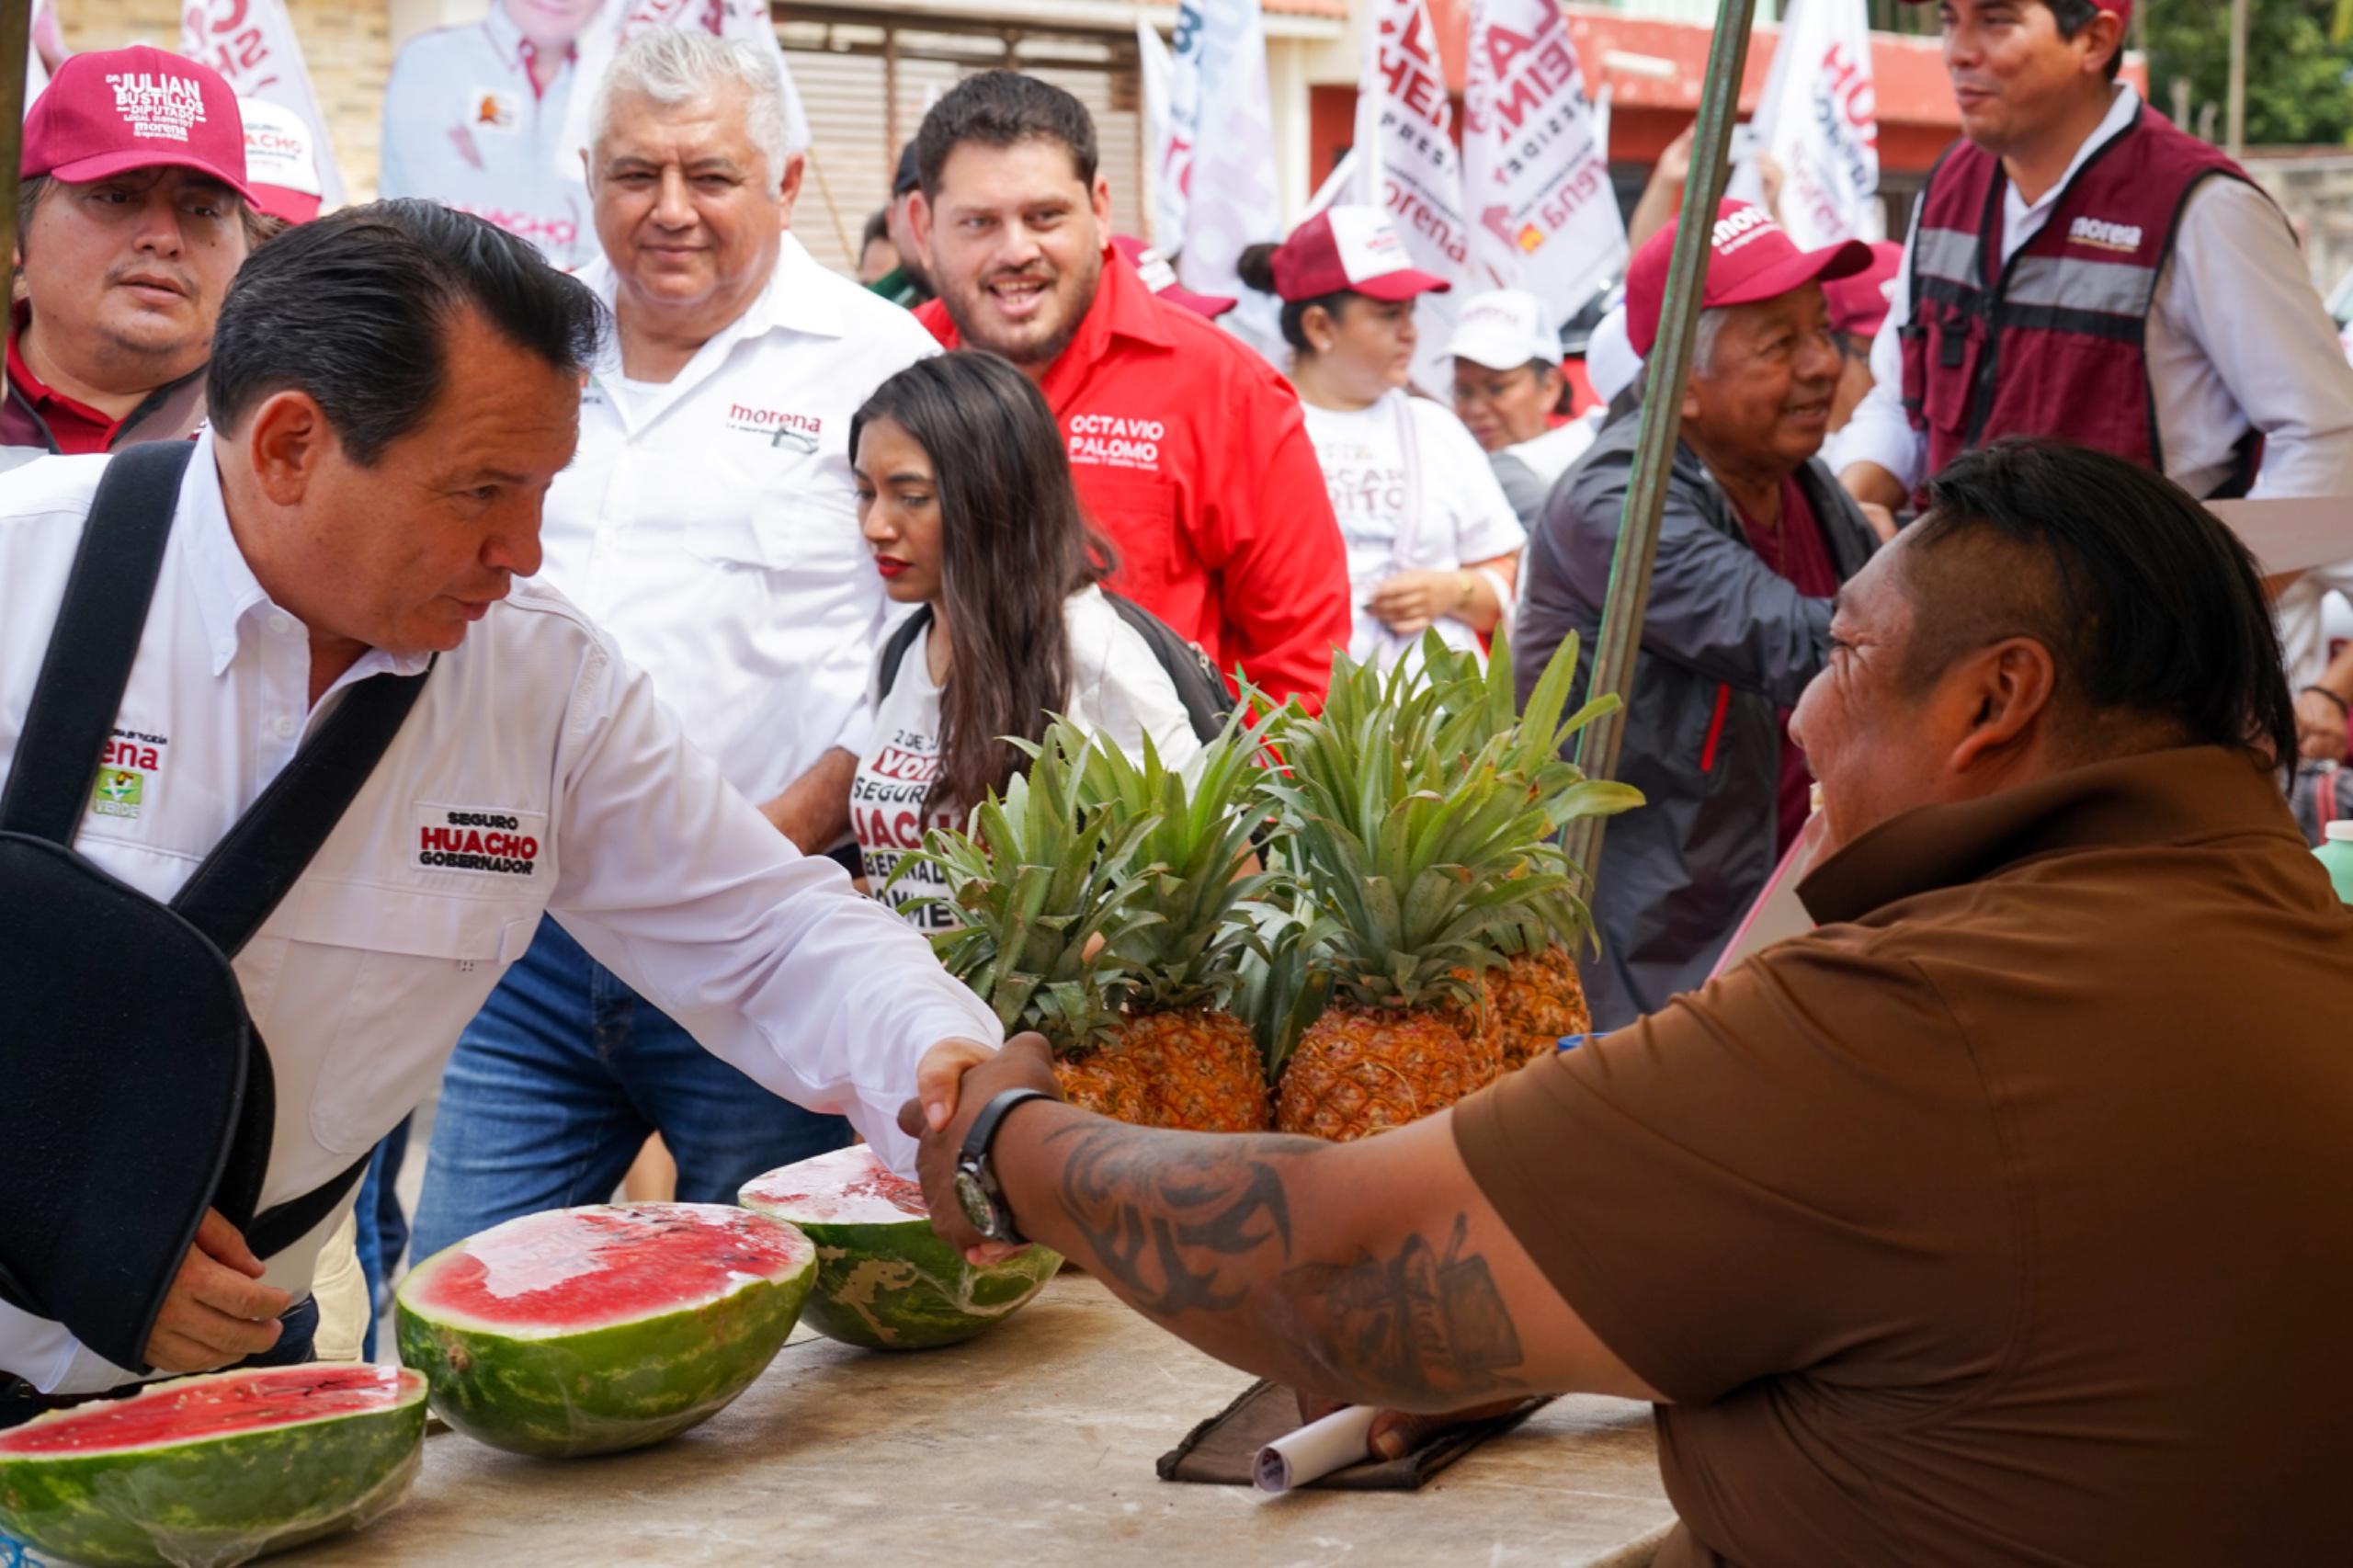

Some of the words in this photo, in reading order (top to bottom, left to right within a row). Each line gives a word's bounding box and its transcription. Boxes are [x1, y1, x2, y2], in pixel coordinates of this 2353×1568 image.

[113, 73, 201, 101] JULIAN
[116, 90, 205, 115] BUSTILLOS
[131, 103, 195, 122] DIPUTADO
[134, 121, 188, 137] morena
[244, 132, 301, 154] ACHO
[729, 403, 823, 433] morena
[1069, 414, 1165, 441] OCTAVIO
[1068, 435, 1159, 462] PALOMO
[100, 740, 159, 771] ena
[854, 777, 928, 805] SEGUR
[447, 812, 519, 831] SEGURO
[420, 826, 539, 860] HUACHO
[419, 850, 534, 875] GOBERNADOR
